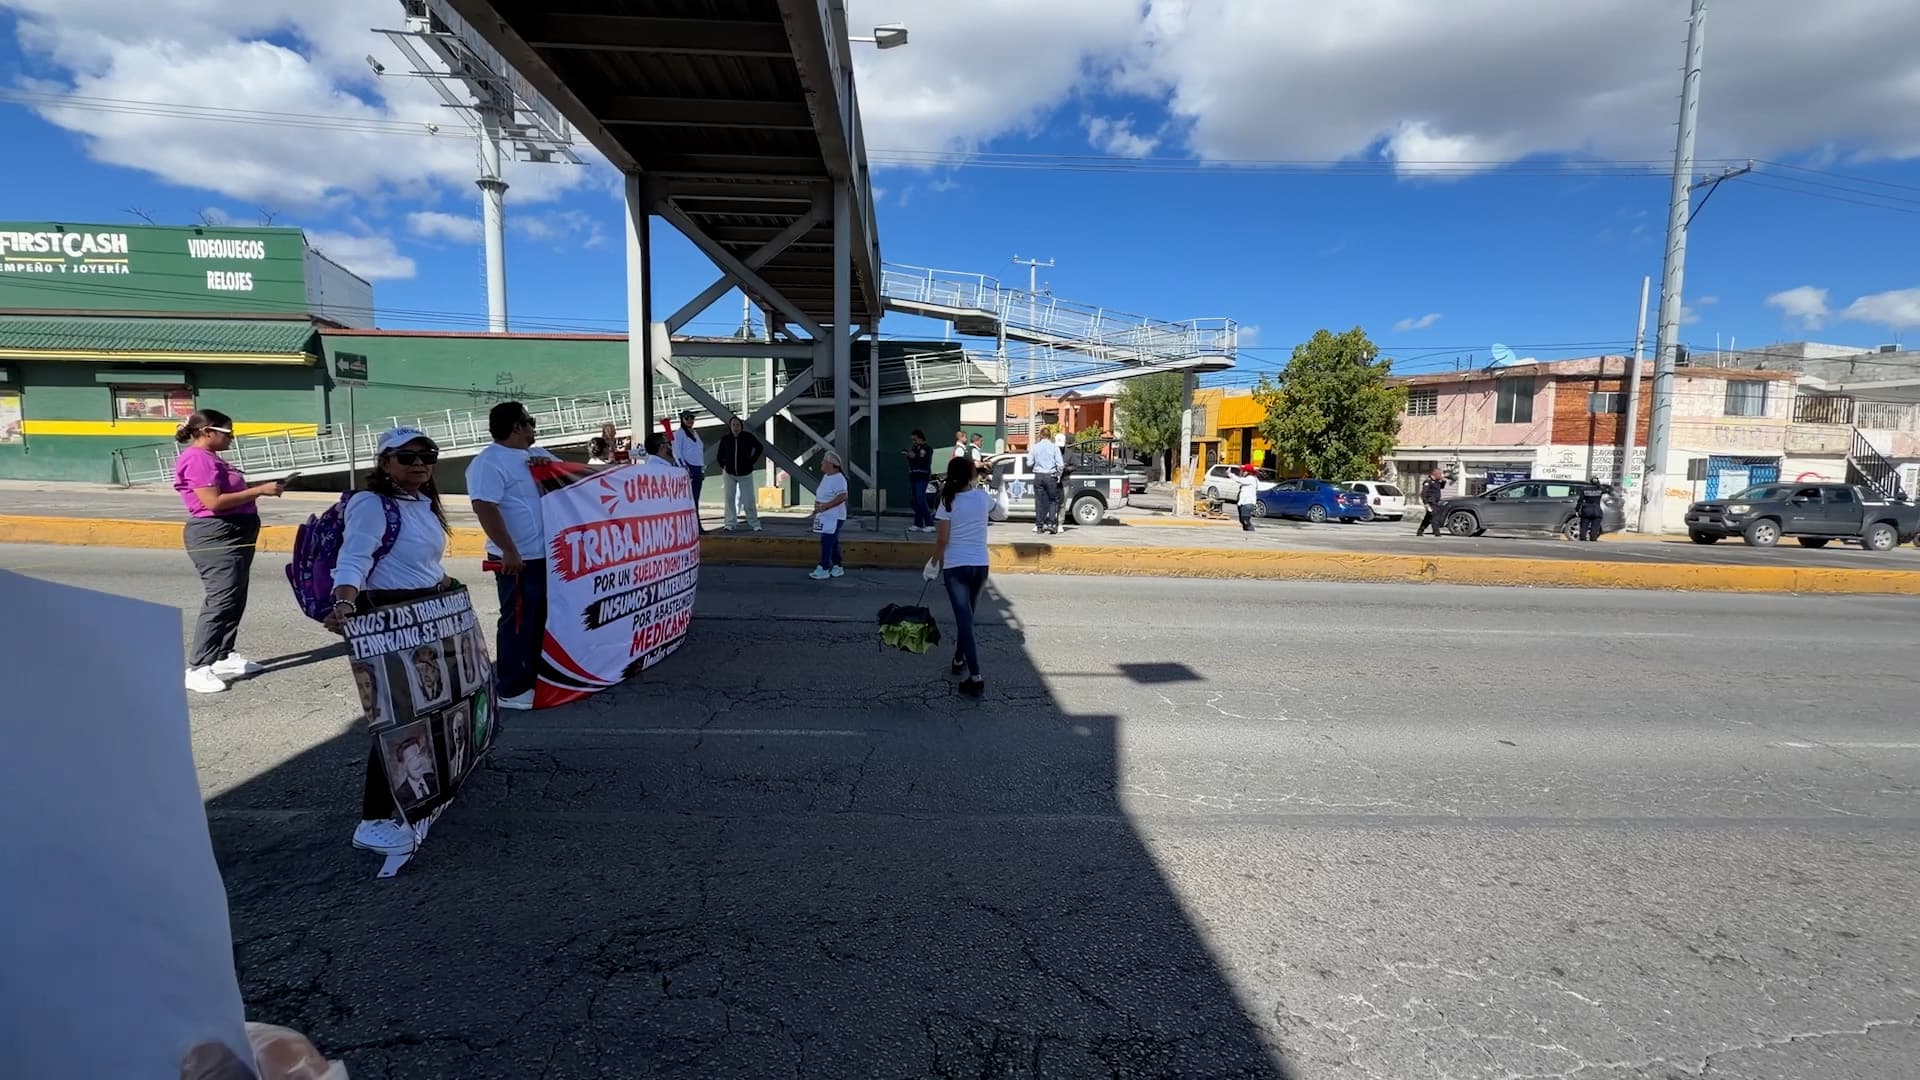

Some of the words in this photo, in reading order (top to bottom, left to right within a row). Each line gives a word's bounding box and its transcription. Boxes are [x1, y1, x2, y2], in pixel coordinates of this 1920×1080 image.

[0, 231, 129, 258] FIRSTCASH
[187, 239, 265, 260] VIDEOJUEGOS
[59, 263, 67, 273] Y
[73, 263, 130, 274] JOYERÍA
[206, 270, 254, 291] RELOJES
[564, 516, 676, 576] TRABAJAMOS
[593, 572, 615, 595] POR
[618, 568, 630, 587] UN
[633, 559, 662, 585] SUELDO
[598, 588, 649, 625] INSUMOS
[649, 584, 657, 604] Y
[388, 606, 413, 629] LOS
[632, 610, 651, 632] POR
[350, 626, 421, 660] TEMPRANO
[422, 621, 438, 644] SE
